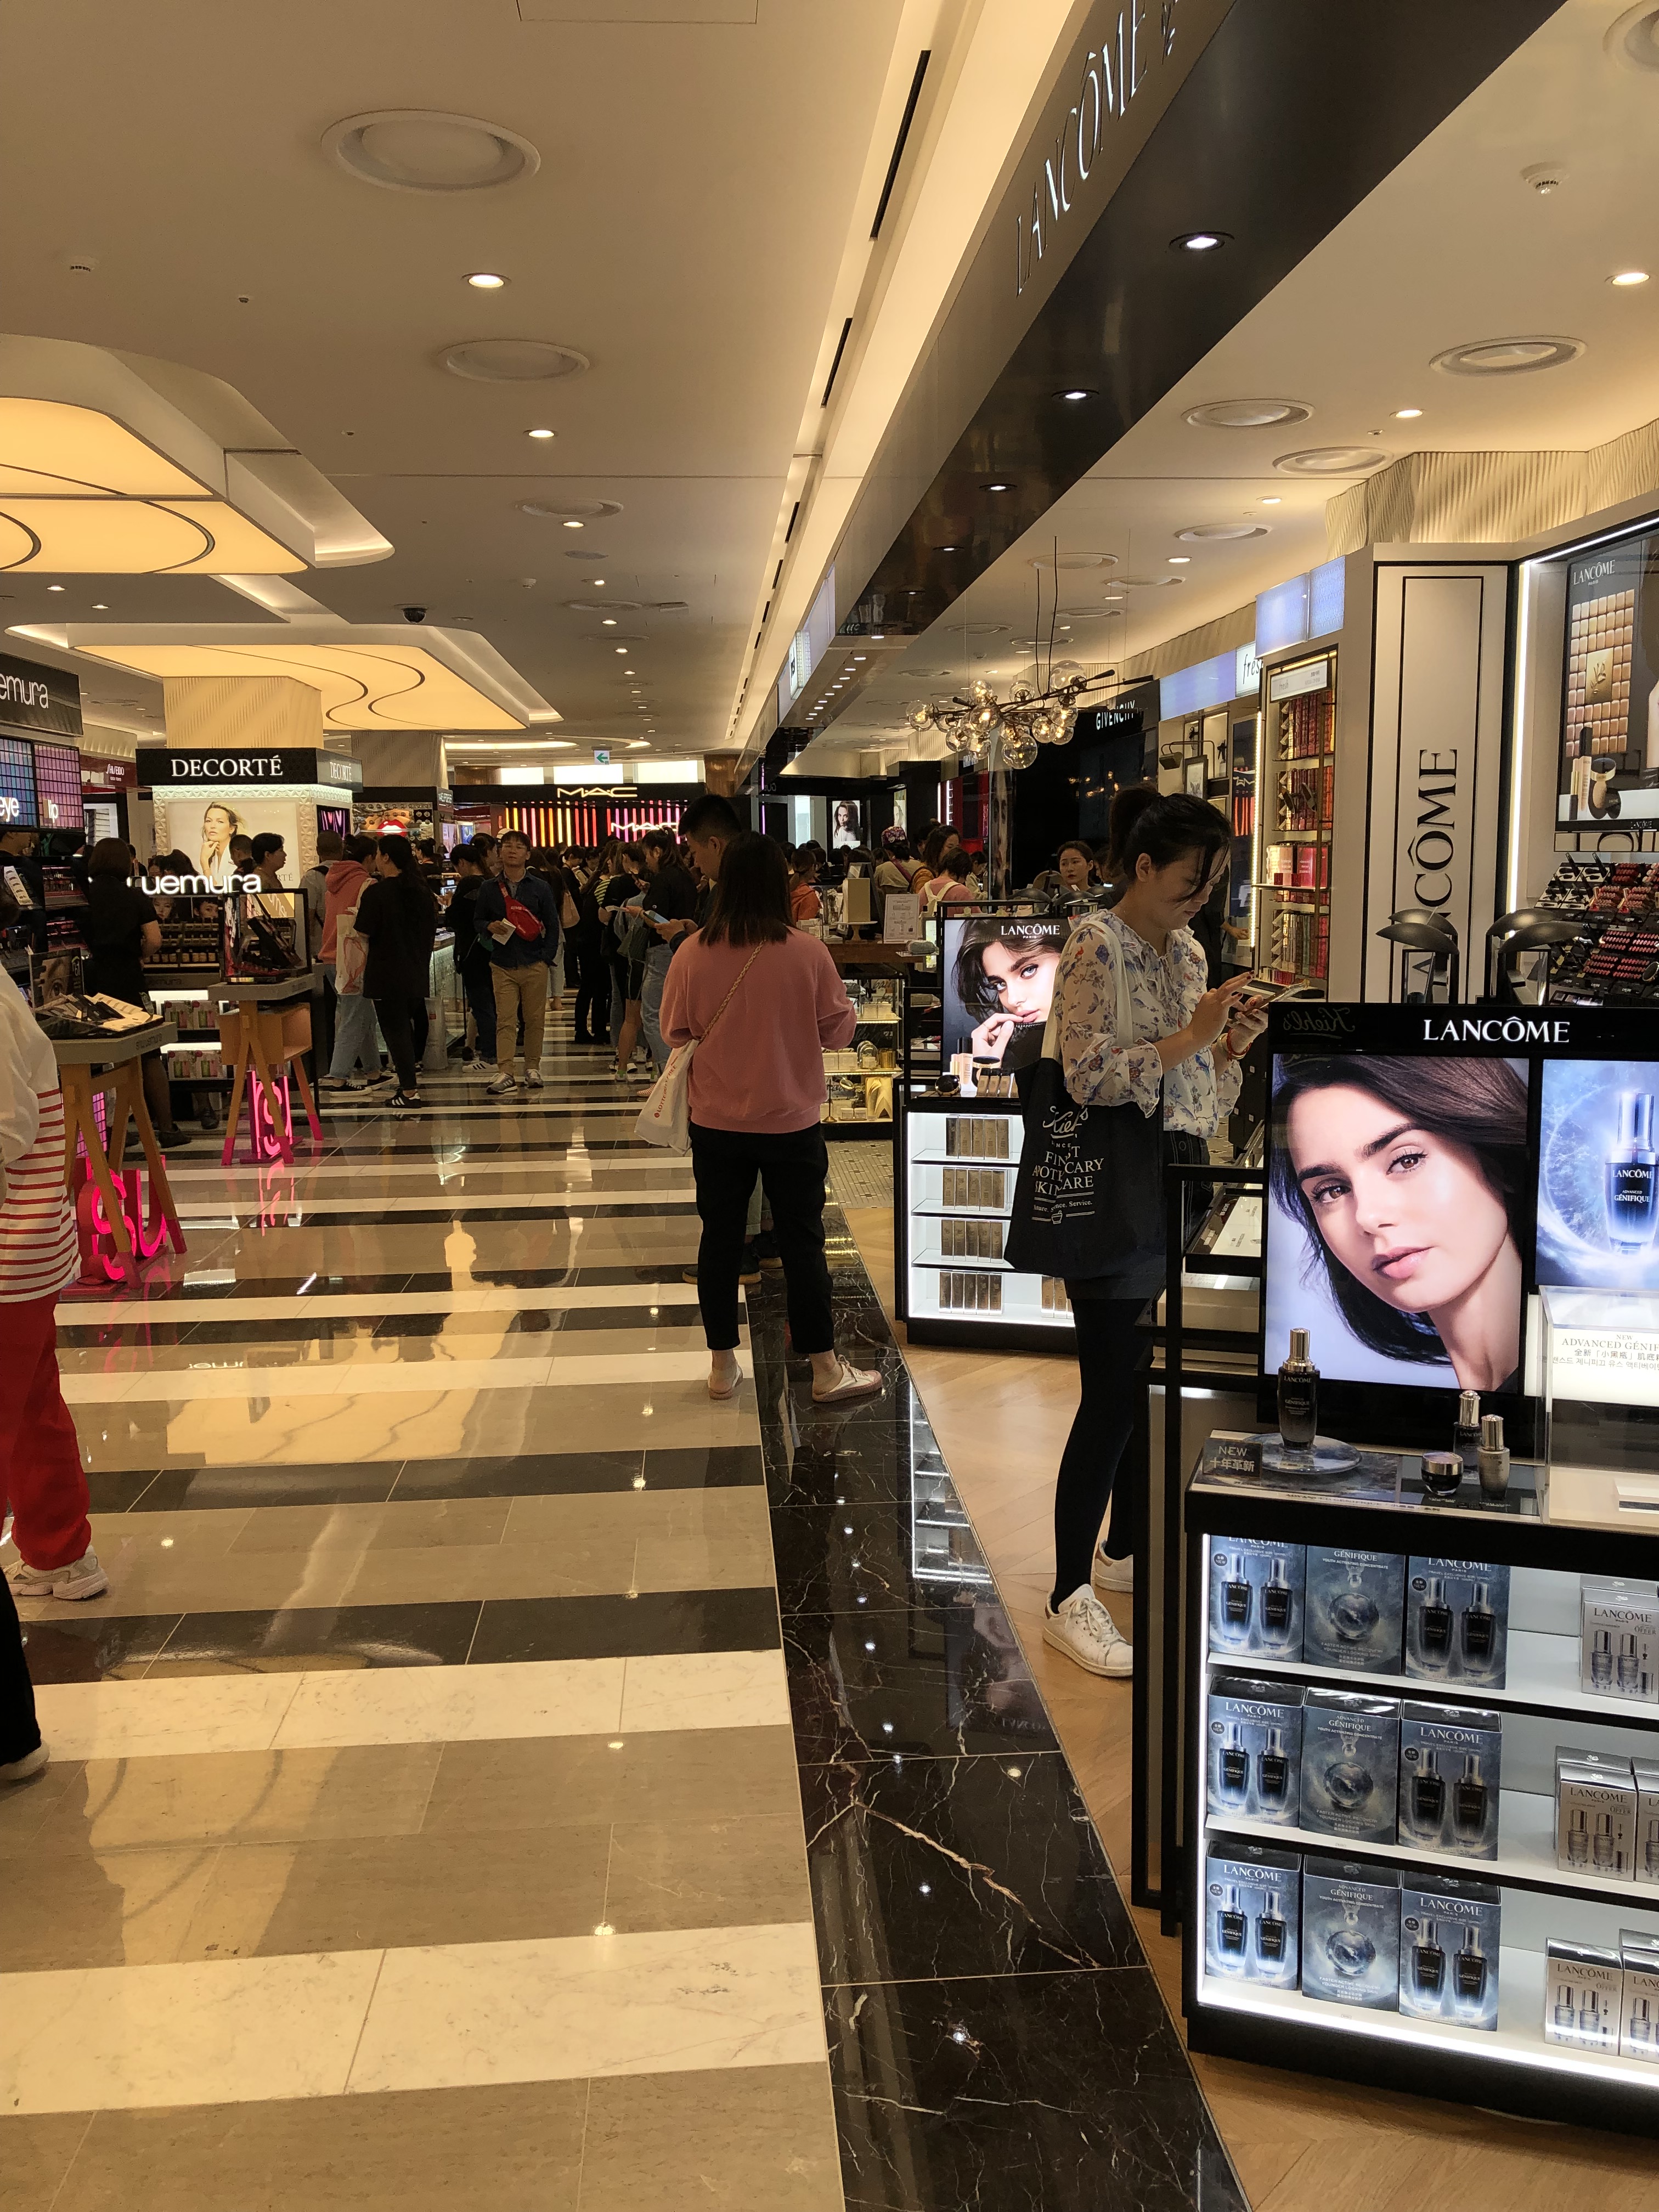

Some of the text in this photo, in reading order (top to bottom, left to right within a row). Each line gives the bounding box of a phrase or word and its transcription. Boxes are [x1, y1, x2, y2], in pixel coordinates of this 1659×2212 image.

[1573, 560, 1616, 585] LANCÔME
[1243, 653, 1261, 685] fres
[106, 763, 125, 776] SHISEIDO
[171, 755, 283, 777] DECORTÉ
[330, 761, 352, 782] DECORTÉ
[47, 799, 58, 823] lip
[141, 873, 262, 895] uemura
[1001, 923, 1060, 935] LANCÔME
[1423, 1016, 1570, 1043] LANCÔME
[1612, 1169, 1654, 1179] LANCÔME
[1614, 1194, 1651, 1204] GÉNIFIQUE
[1562, 1339, 1621, 1348] ADVANCED
[1218, 1446, 1248, 1457] NEW
[1210, 1457, 1255, 1472] 十年革新
[1334, 1550, 1378, 1561] GÉNIFIQUE
[1594, 1607, 1652, 1623] LANCÔME
[1226, 1702, 1284, 1718] LANCÔME
[1329, 1720, 1372, 1732] GÉNIFIQUE
[1420, 1727, 1483, 1744] LANCÔME
[1571, 1787, 1627, 1803] LANCÔME
[1224, 1864, 1282, 1882] LANCÔME
[1330, 1889, 1373, 1901] GÉNIFIQUE
[1420, 1897, 1483, 1916] LANCÔME
[1558, 1963, 1613, 1981] LANCÔME
